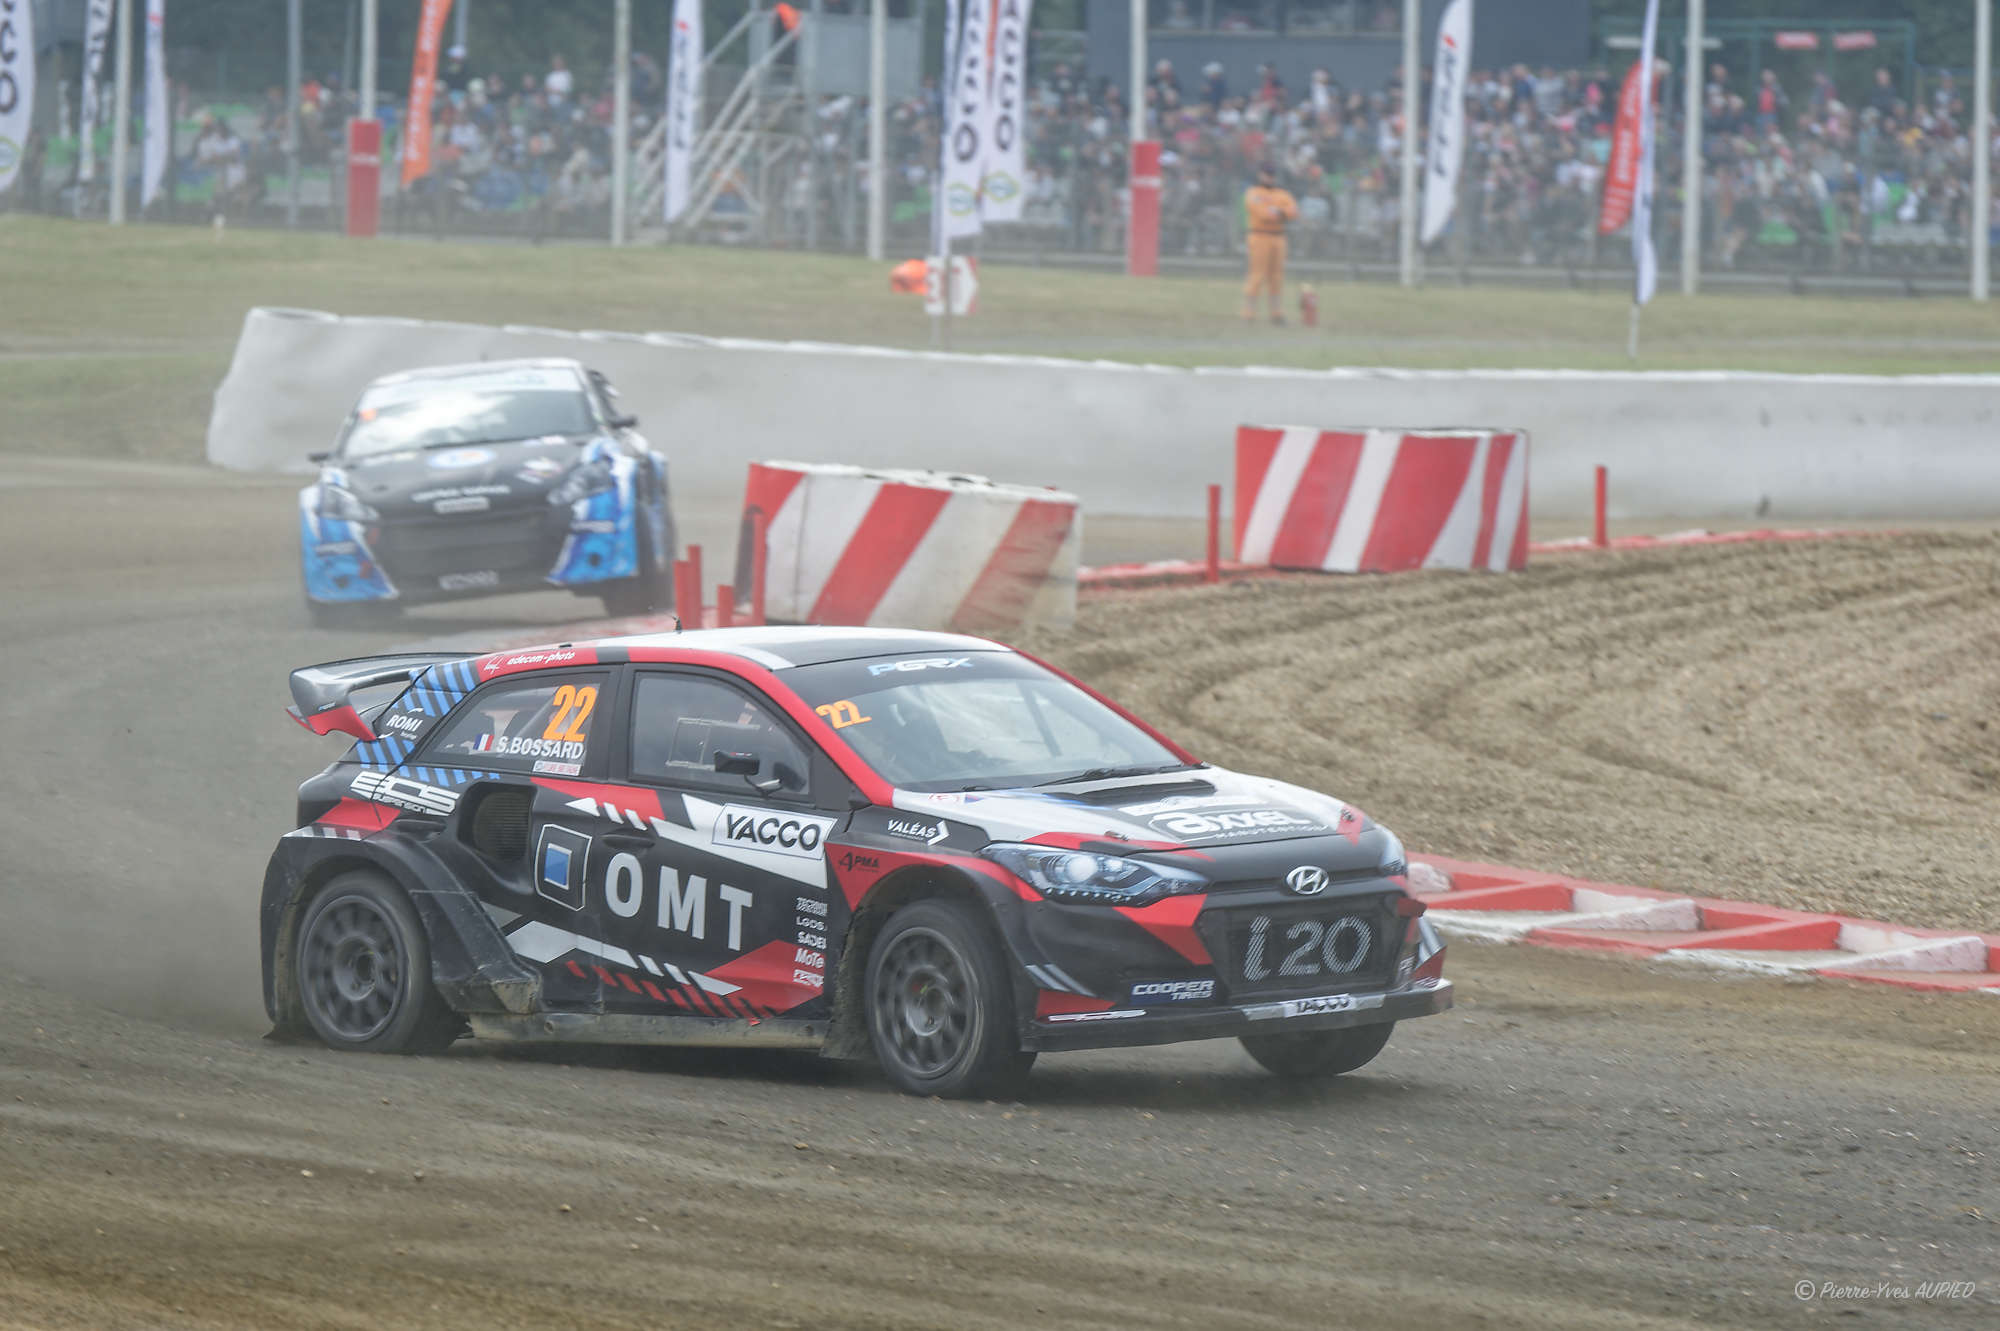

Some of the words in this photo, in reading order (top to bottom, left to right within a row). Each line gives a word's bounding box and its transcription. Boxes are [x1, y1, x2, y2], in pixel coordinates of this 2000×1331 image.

[386, 714, 423, 731] ROMI
[542, 684, 598, 742] 22
[815, 699, 872, 729] 22
[496, 736, 585, 759] S.BOSSARD
[726, 813, 821, 851] YACCO
[887, 819, 937, 838] VALÉAS
[605, 852, 753, 951] OMT
[1132, 980, 1215, 995] COOPER
